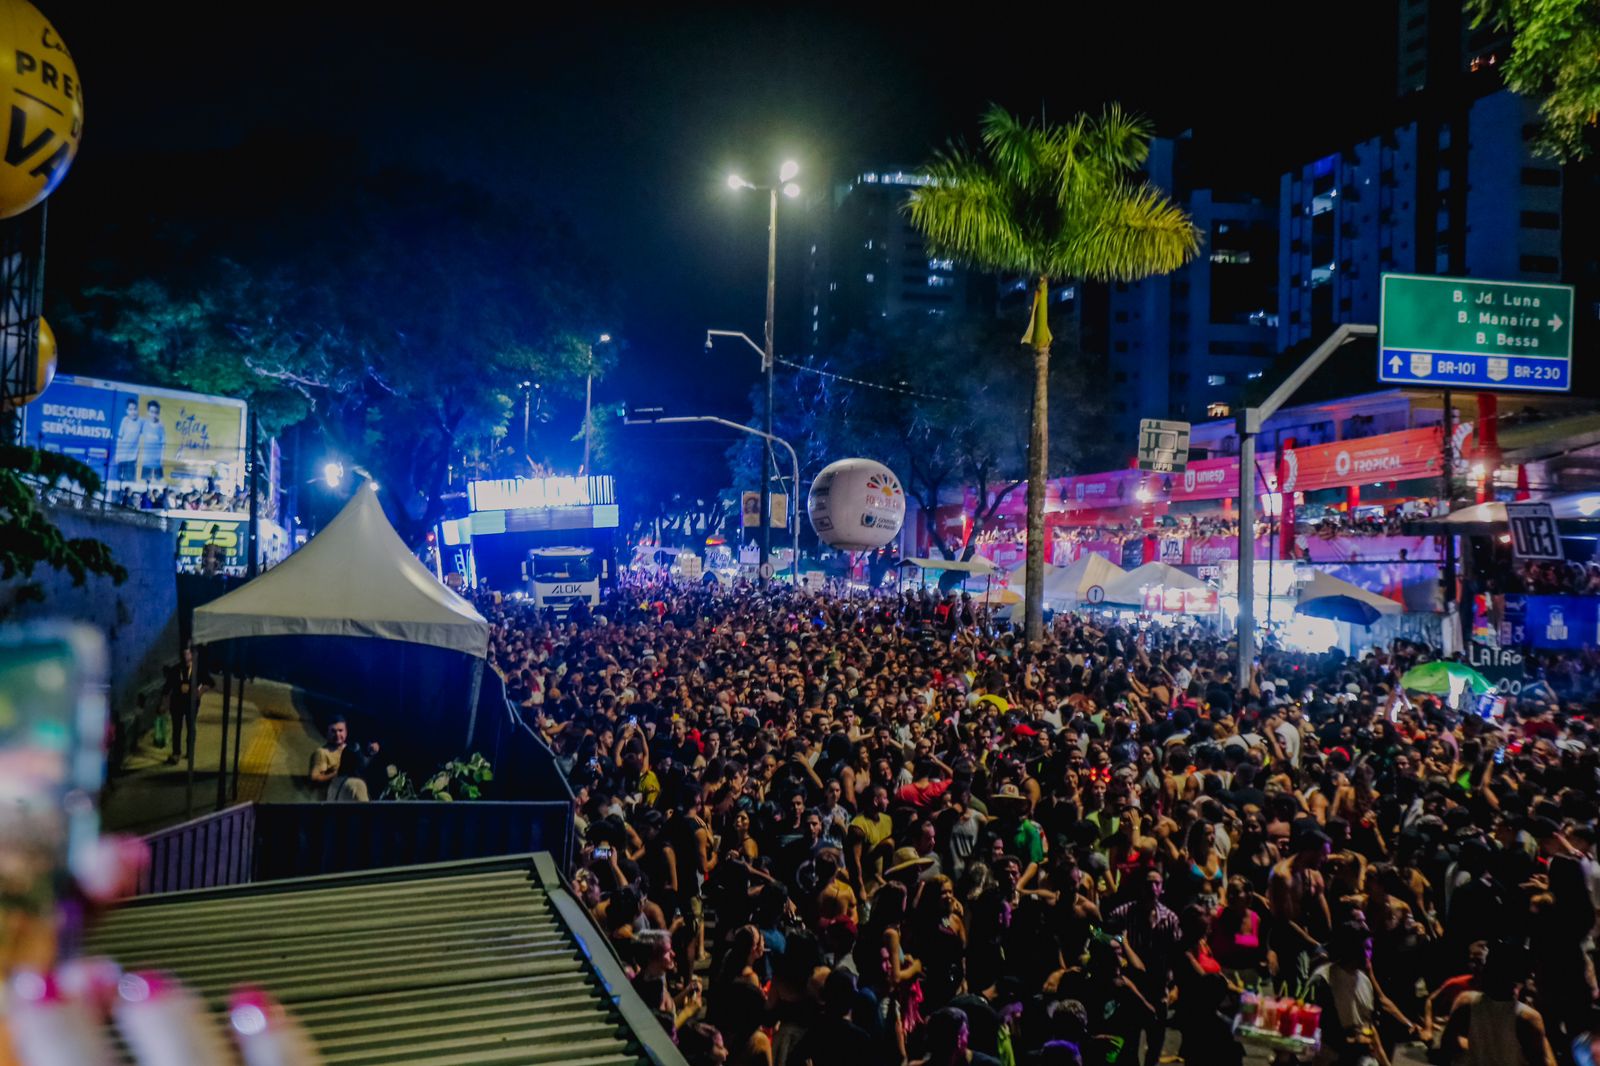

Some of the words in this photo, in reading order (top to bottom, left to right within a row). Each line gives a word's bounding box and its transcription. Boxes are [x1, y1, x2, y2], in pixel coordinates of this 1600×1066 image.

[1453, 290, 1467, 303] B.
[1475, 291, 1496, 305] Jd.
[1503, 292, 1540, 307] Luna
[1458, 311, 1470, 324] B.
[1476, 332, 1489, 345] B.
[1497, 333, 1539, 348] Bessa
[1437, 361, 1476, 375] BR-101
[1514, 365, 1561, 380] BR-230
[42, 403, 105, 421] DESCUBRA
[1152, 462, 1173, 471] UFPB
[1353, 455, 1402, 473] TROPICAL
[1197, 469, 1225, 484] uniesp
[551, 584, 582, 594] ALOK
